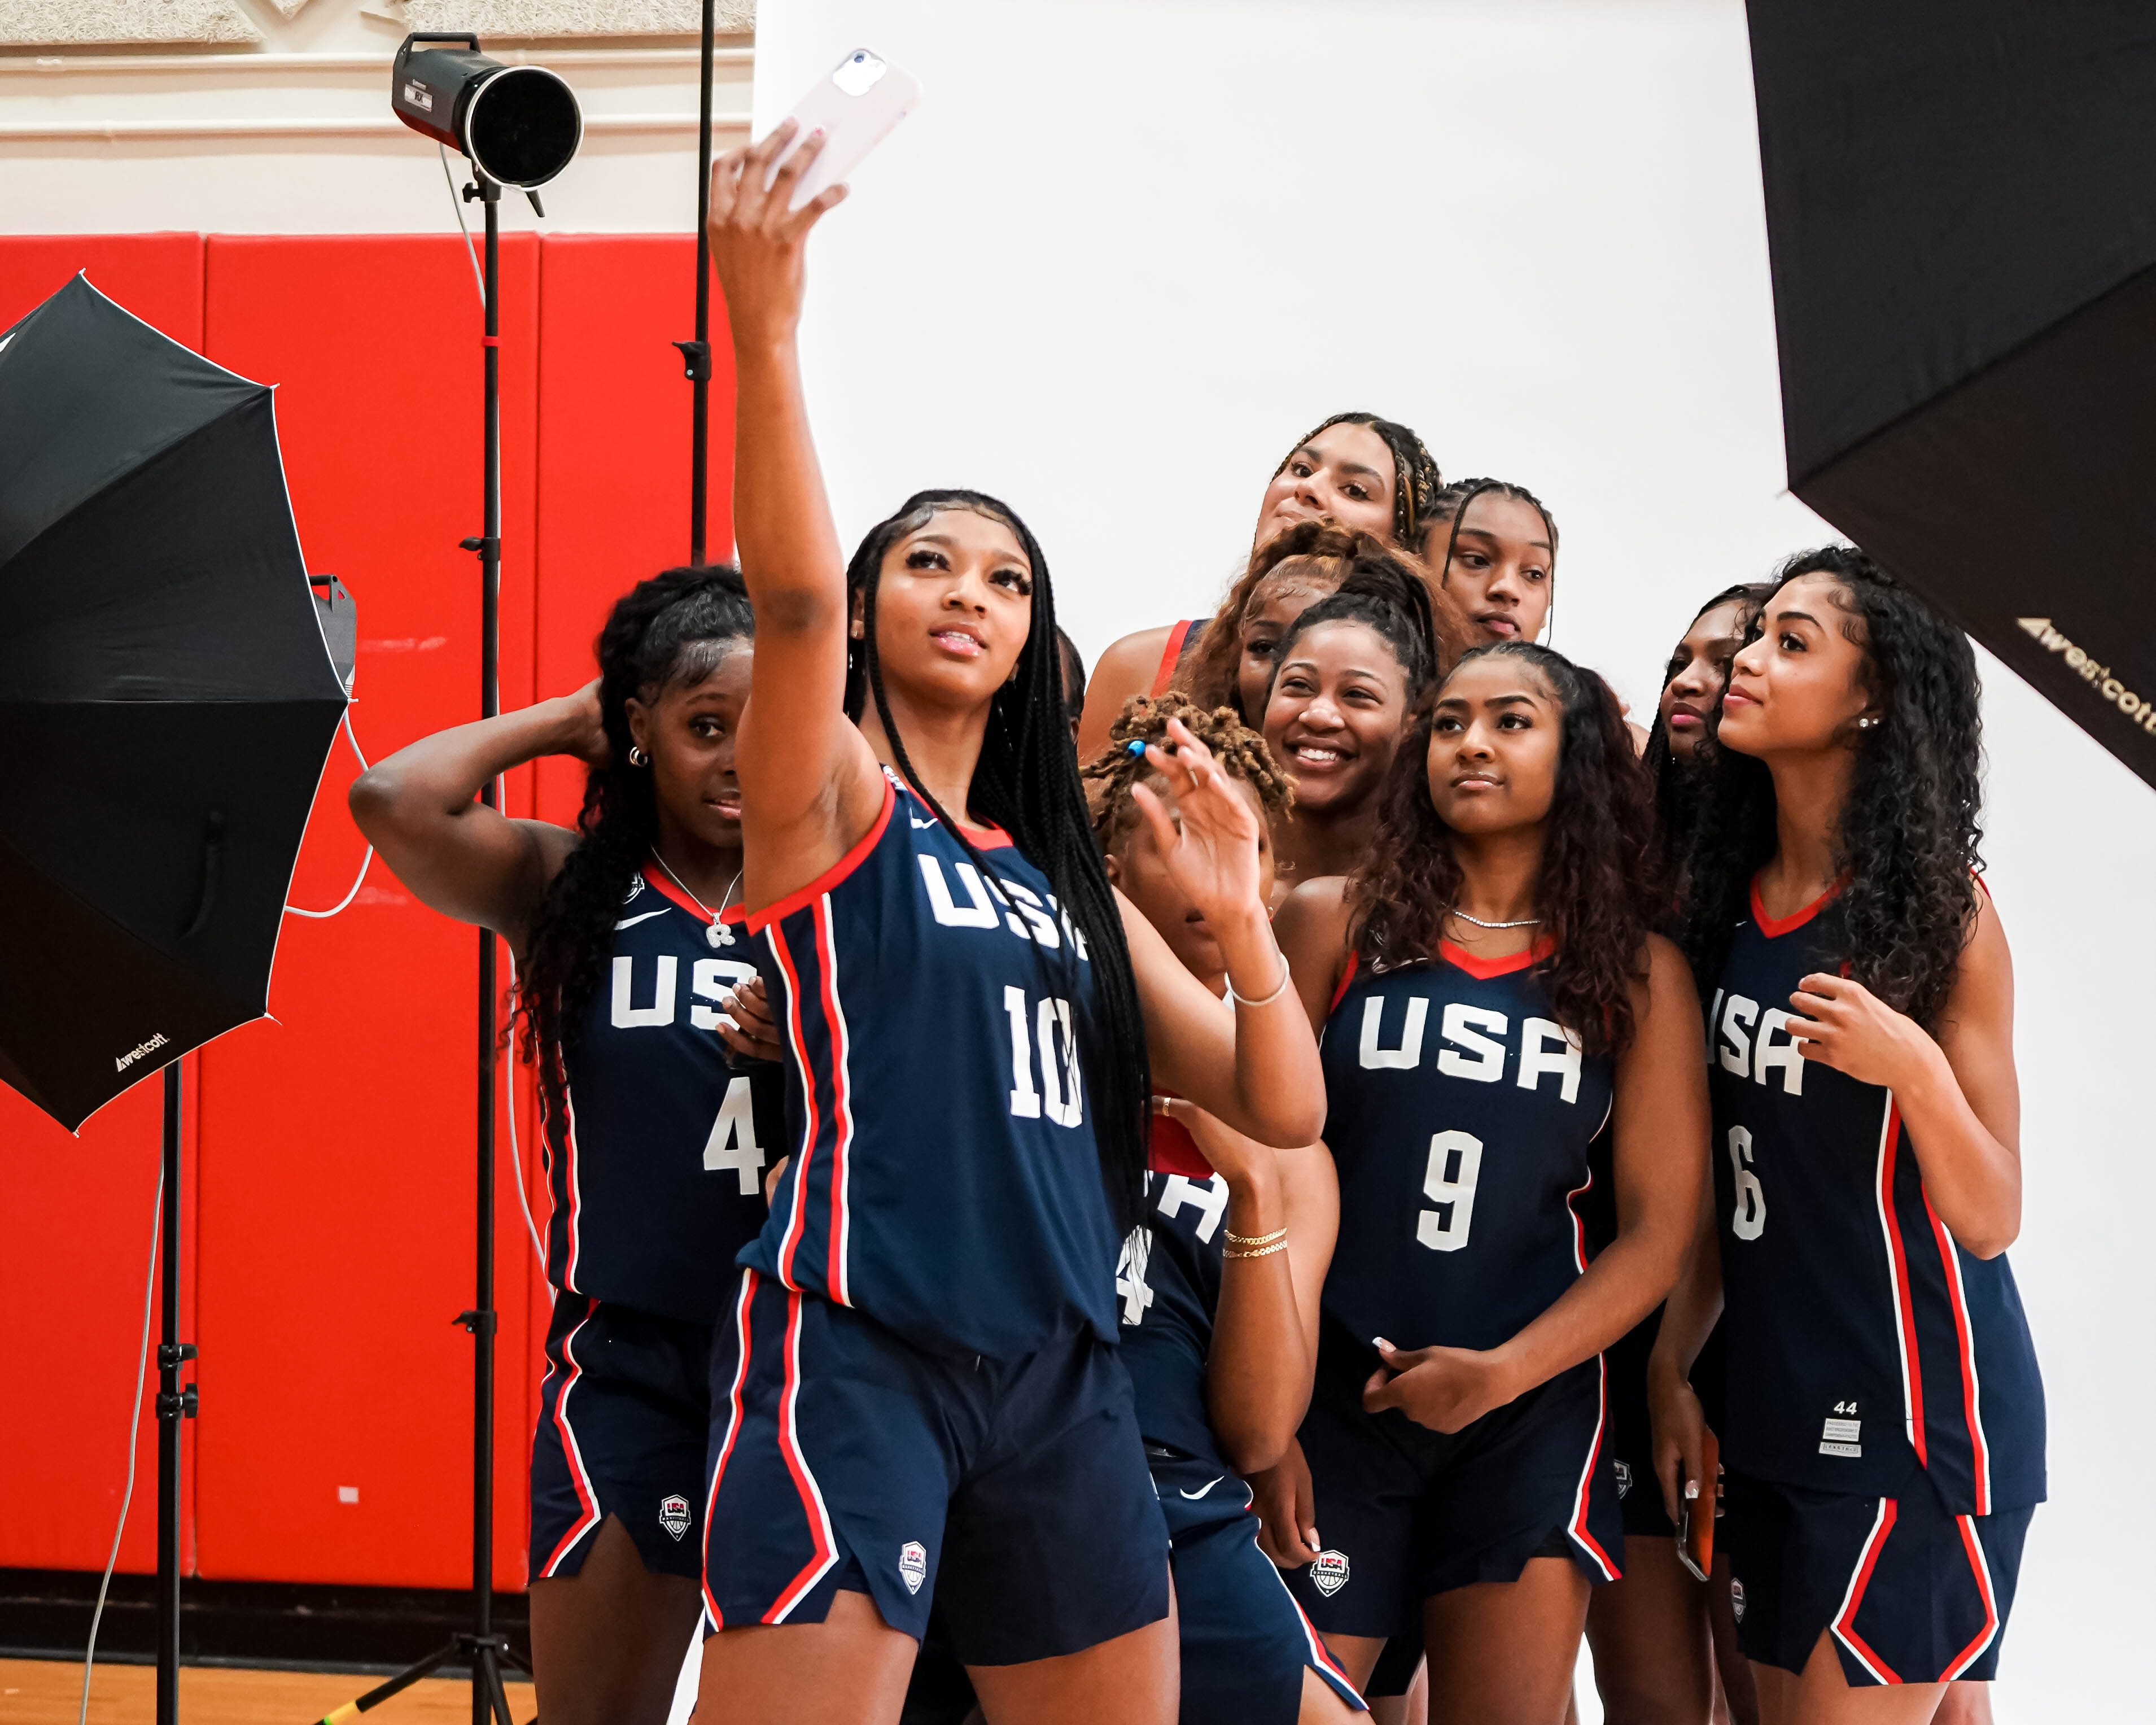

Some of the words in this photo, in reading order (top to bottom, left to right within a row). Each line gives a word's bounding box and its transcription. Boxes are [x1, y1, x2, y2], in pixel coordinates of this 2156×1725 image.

[610, 955, 758, 1030] US
[120, 1032, 169, 1066] westcott
[1003, 985, 1083, 1129] 10
[1359, 995, 1583, 1104] USA
[703, 1076, 766, 1195] 4
[1728, 1124, 1767, 1241] 6
[1416, 1129, 1484, 1252] 9
[1833, 1400, 1857, 1415] 44
[1321, 1558, 1342, 1570] USA
